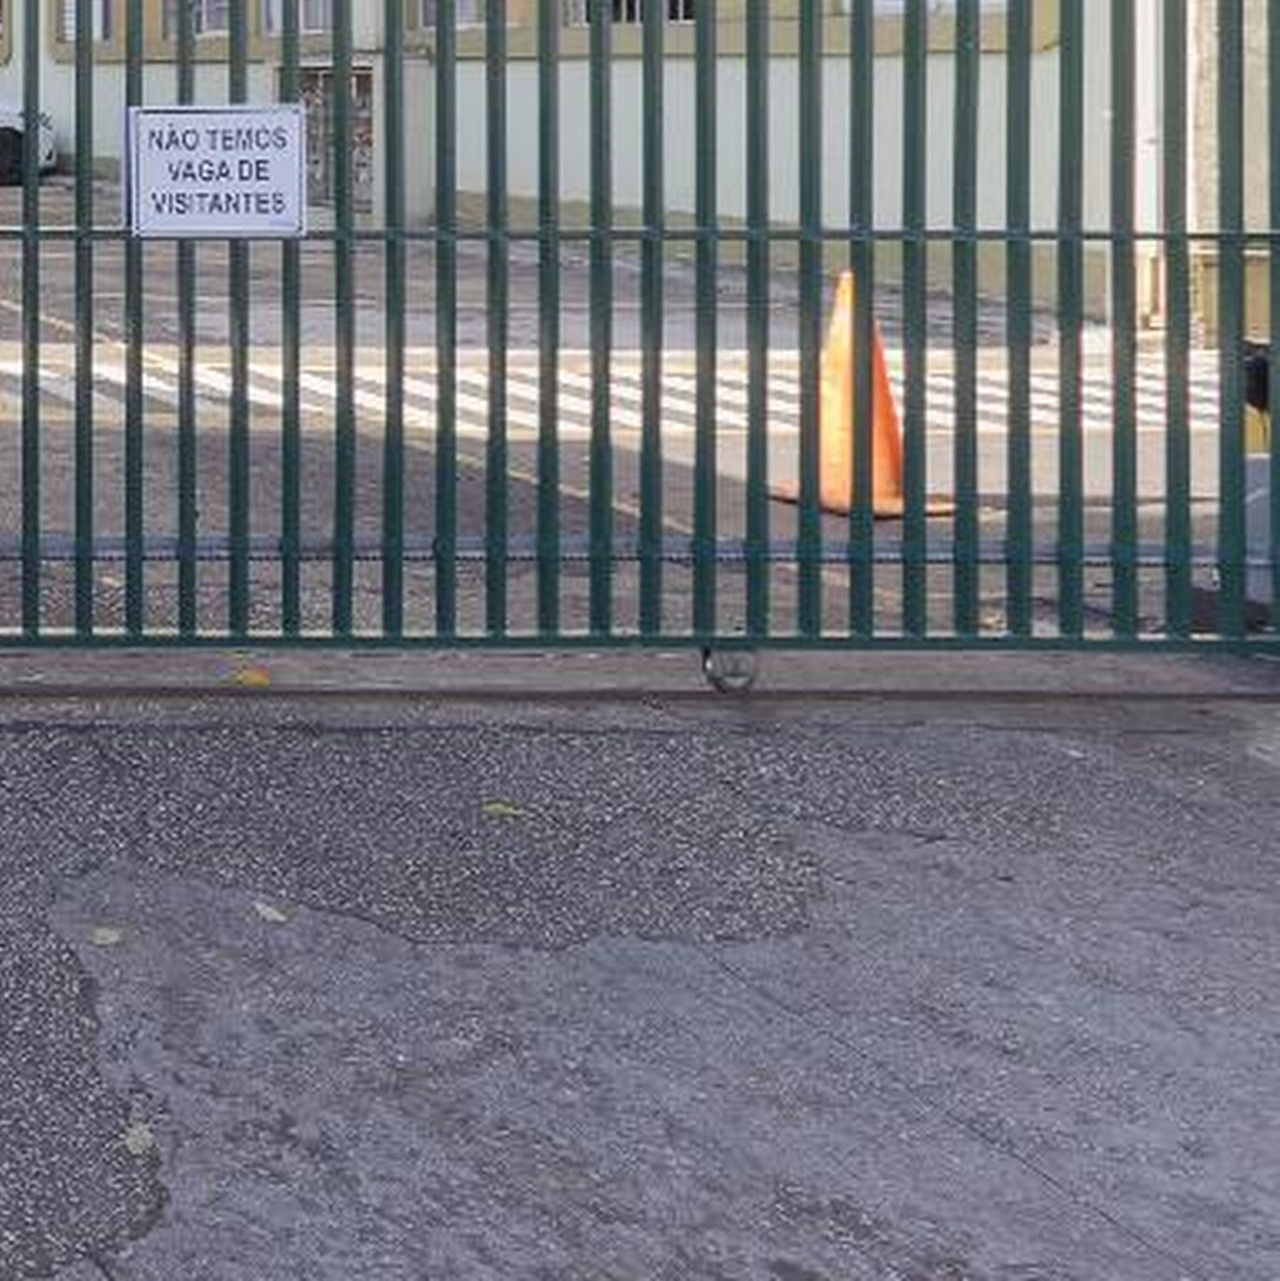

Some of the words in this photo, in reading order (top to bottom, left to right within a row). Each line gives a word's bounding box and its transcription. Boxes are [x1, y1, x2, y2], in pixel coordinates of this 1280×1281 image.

[148, 123, 200, 151] NÃO
[206, 127, 288, 151] TEMOS
[168, 159, 231, 182] VAGA
[238, 159, 271, 182] DE
[151, 192, 287, 215] VISITANTES
